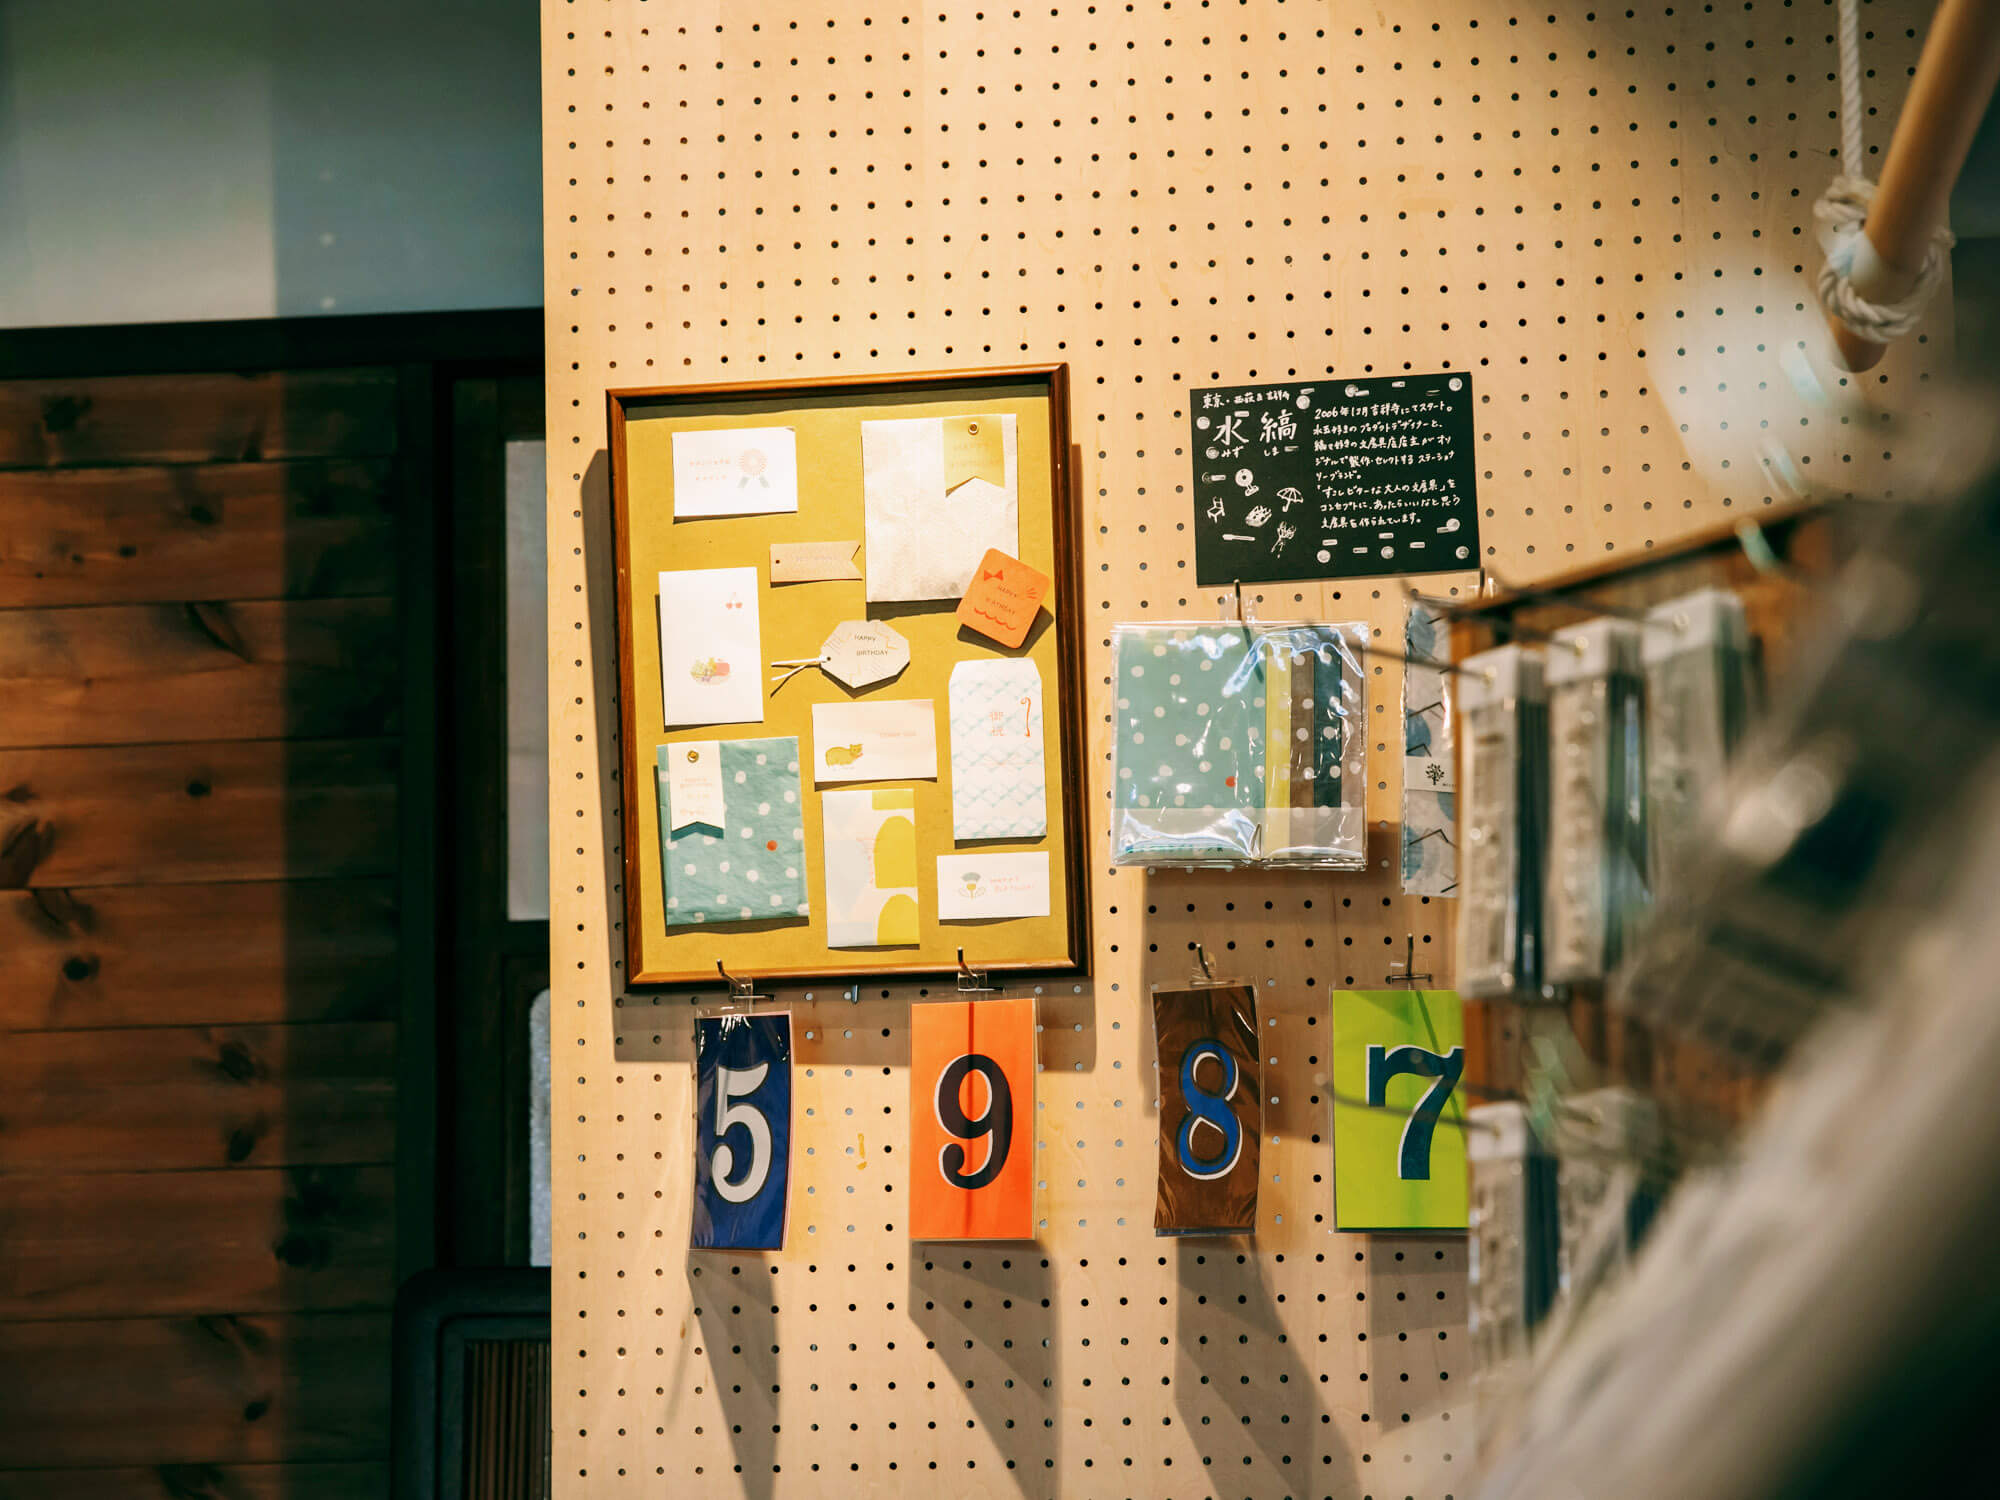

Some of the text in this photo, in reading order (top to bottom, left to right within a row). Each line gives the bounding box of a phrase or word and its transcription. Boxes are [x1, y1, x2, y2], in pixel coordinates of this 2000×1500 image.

[1213, 409, 1297, 445] 水 縞
[856, 649, 889, 657] BIRTHDAY
[711, 1062, 773, 1203] 5
[934, 1053, 1013, 1190] 9
[1175, 1038, 1243, 1180] 8
[1366, 1044, 1463, 1180] 7
